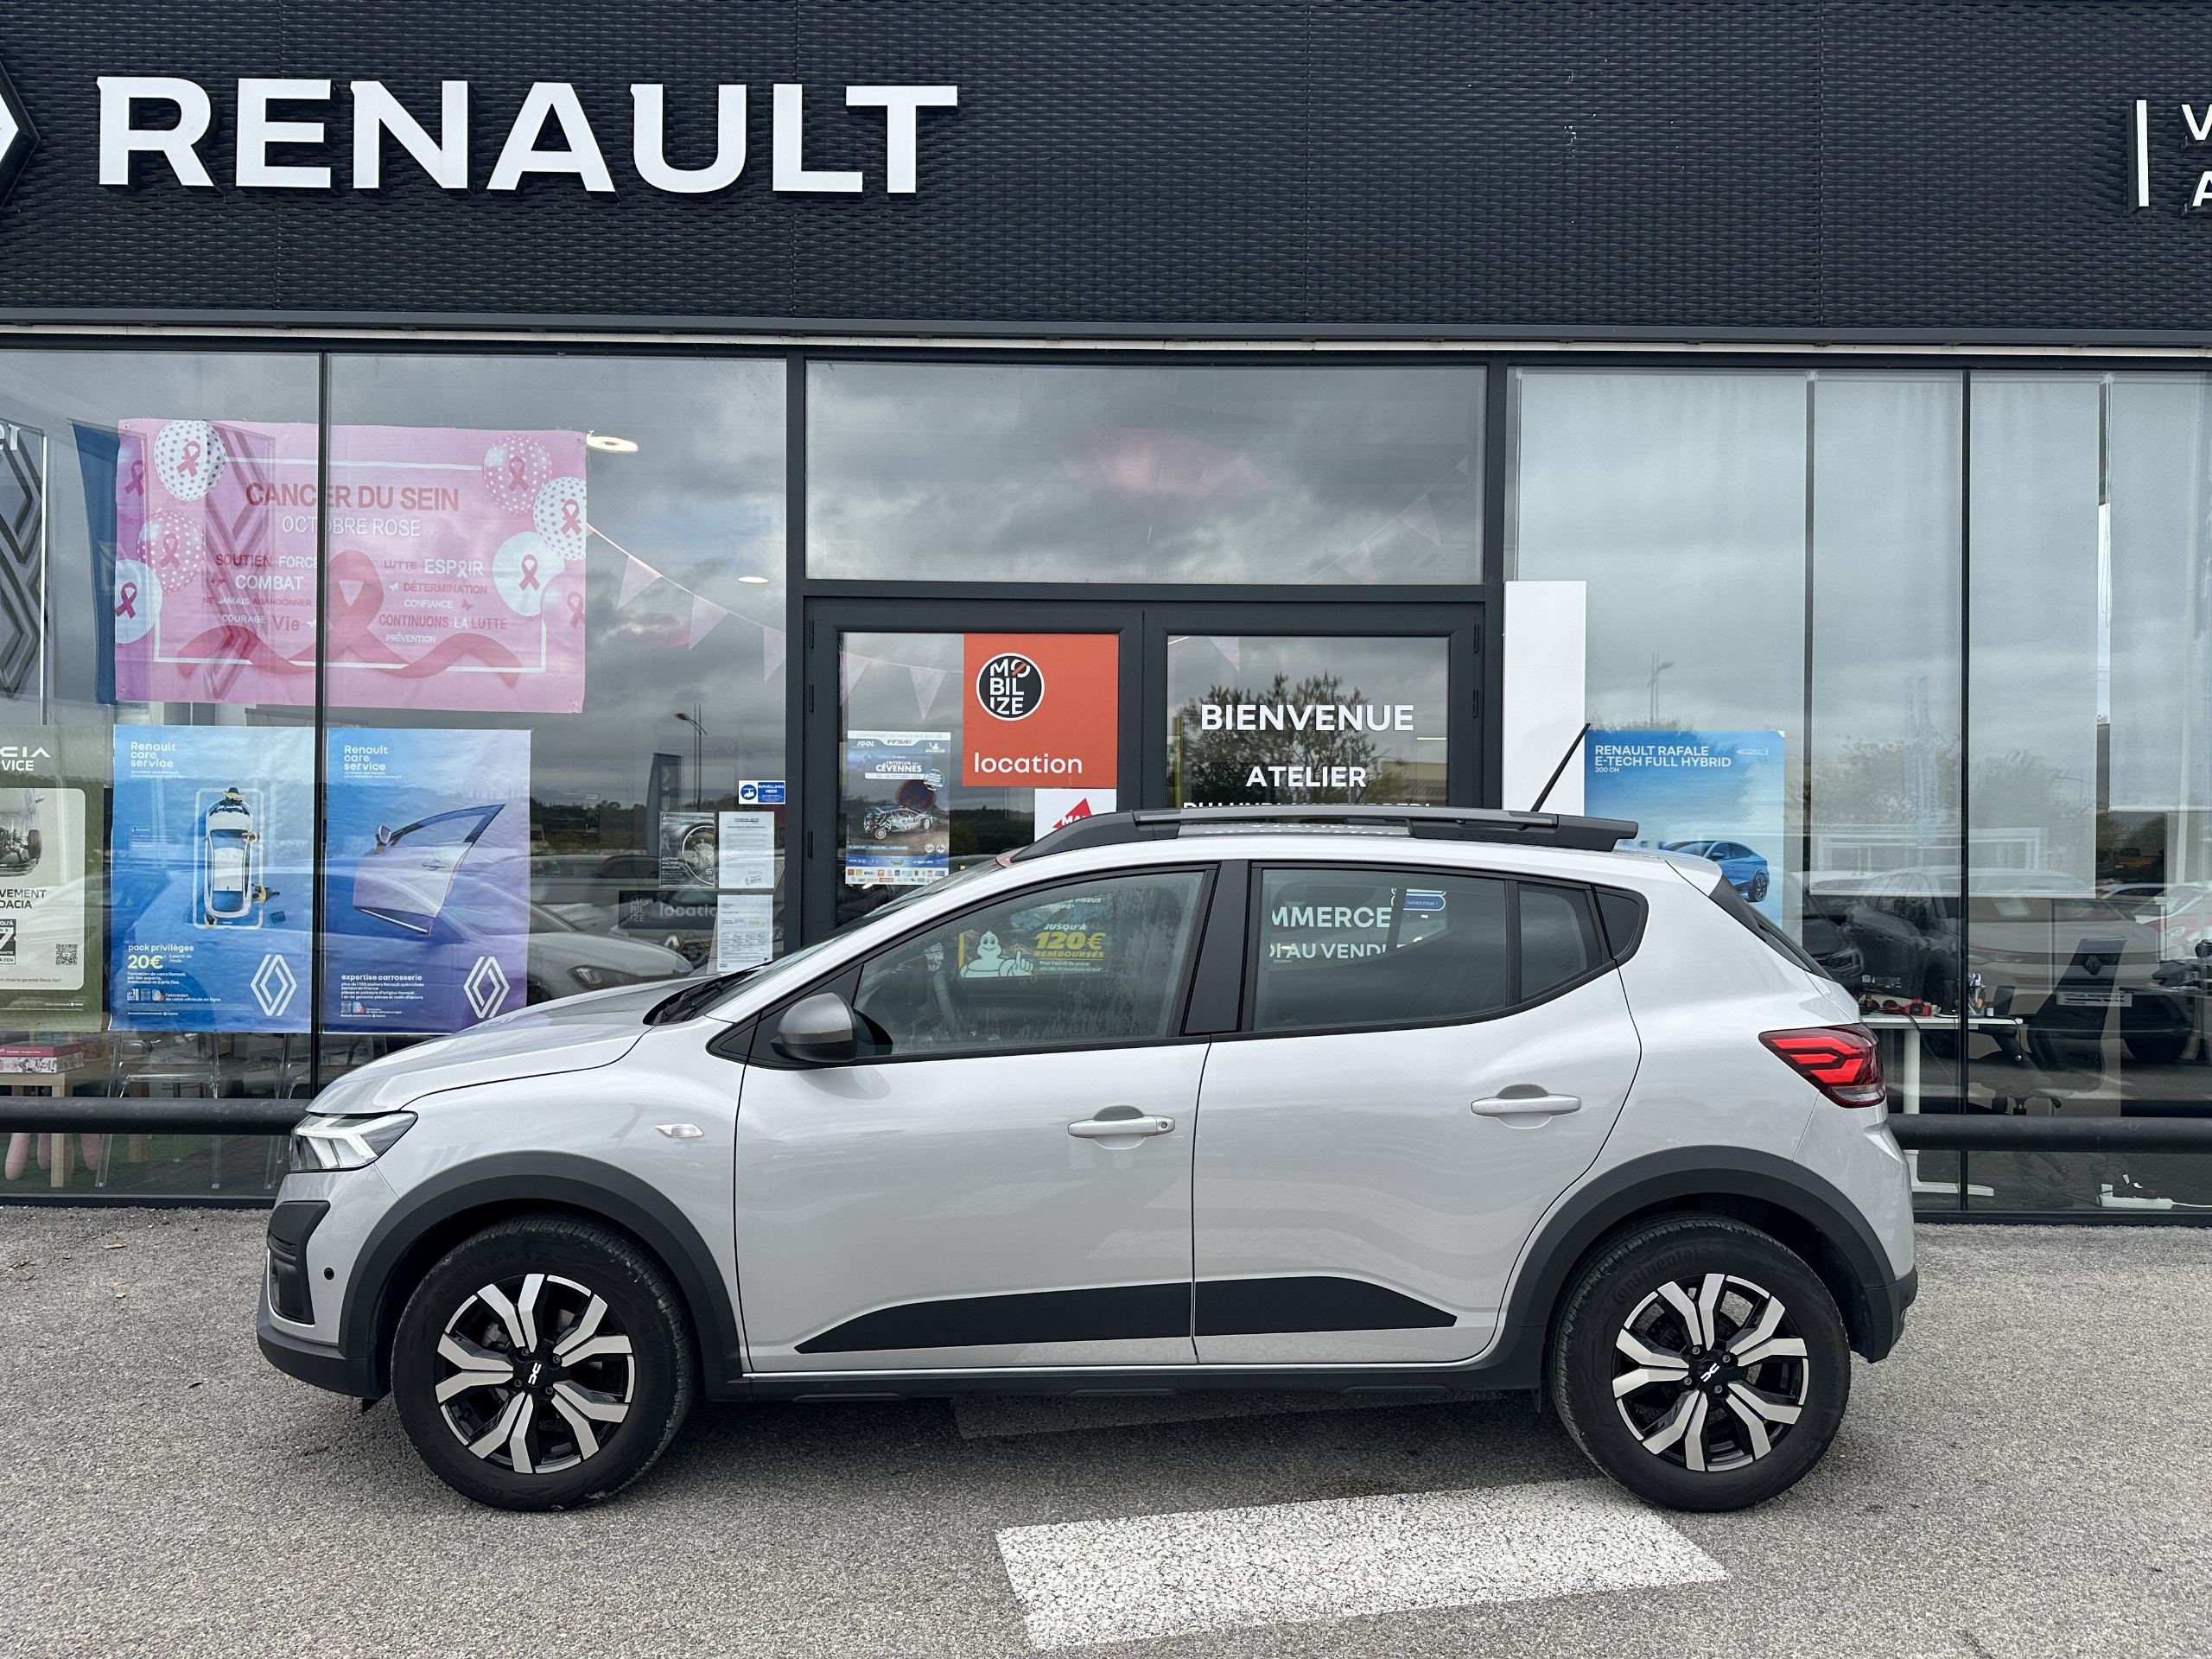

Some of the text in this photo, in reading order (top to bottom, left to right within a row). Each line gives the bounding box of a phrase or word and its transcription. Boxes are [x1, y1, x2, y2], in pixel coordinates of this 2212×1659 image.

[97, 76, 958, 195] RENAULT
[359, 486, 394, 509] DU
[400, 486, 459, 512] SEIN
[373, 518, 421, 537] ROSE
[216, 554, 272, 567] SOUTIEN
[384, 560, 416, 569] LUTTE
[235, 574, 304, 591] COMBAT
[404, 580, 487, 594] DÉTERMINATION
[252, 598, 312, 607] ABANDONNER
[404, 599, 453, 609] CONFIANCE
[222, 614, 300, 632] COURAGE Vie
[378, 613, 507, 630] CONTINUONS LA LUTTE
[385, 632, 435, 643] PRÉVENTION
[1201, 704, 1414, 731] BIENVENUE
[130, 741, 176, 751] Renault
[344, 745, 389, 754] Renault
[1595, 745, 1709, 756] RENAULT RAFALE
[2, 760, 35, 772] VICE
[130, 759, 175, 767] service
[344, 761, 386, 771] service
[875, 763, 922, 772] CÉVENNES
[974, 752, 1083, 773] location
[1595, 756, 1732, 767] E-TECH FULL HYBRID
[1246, 766, 1367, 787] ATELIER
[1272, 906, 1392, 928] MMERCE
[1044, 923, 1087, 931] JUSQU'À
[1036, 931, 1106, 950] 120€
[128, 943, 194, 953] pack privilèges
[1033, 950, 1105, 958] REMBOURSÉS
[1286, 943, 1316, 958] AU
